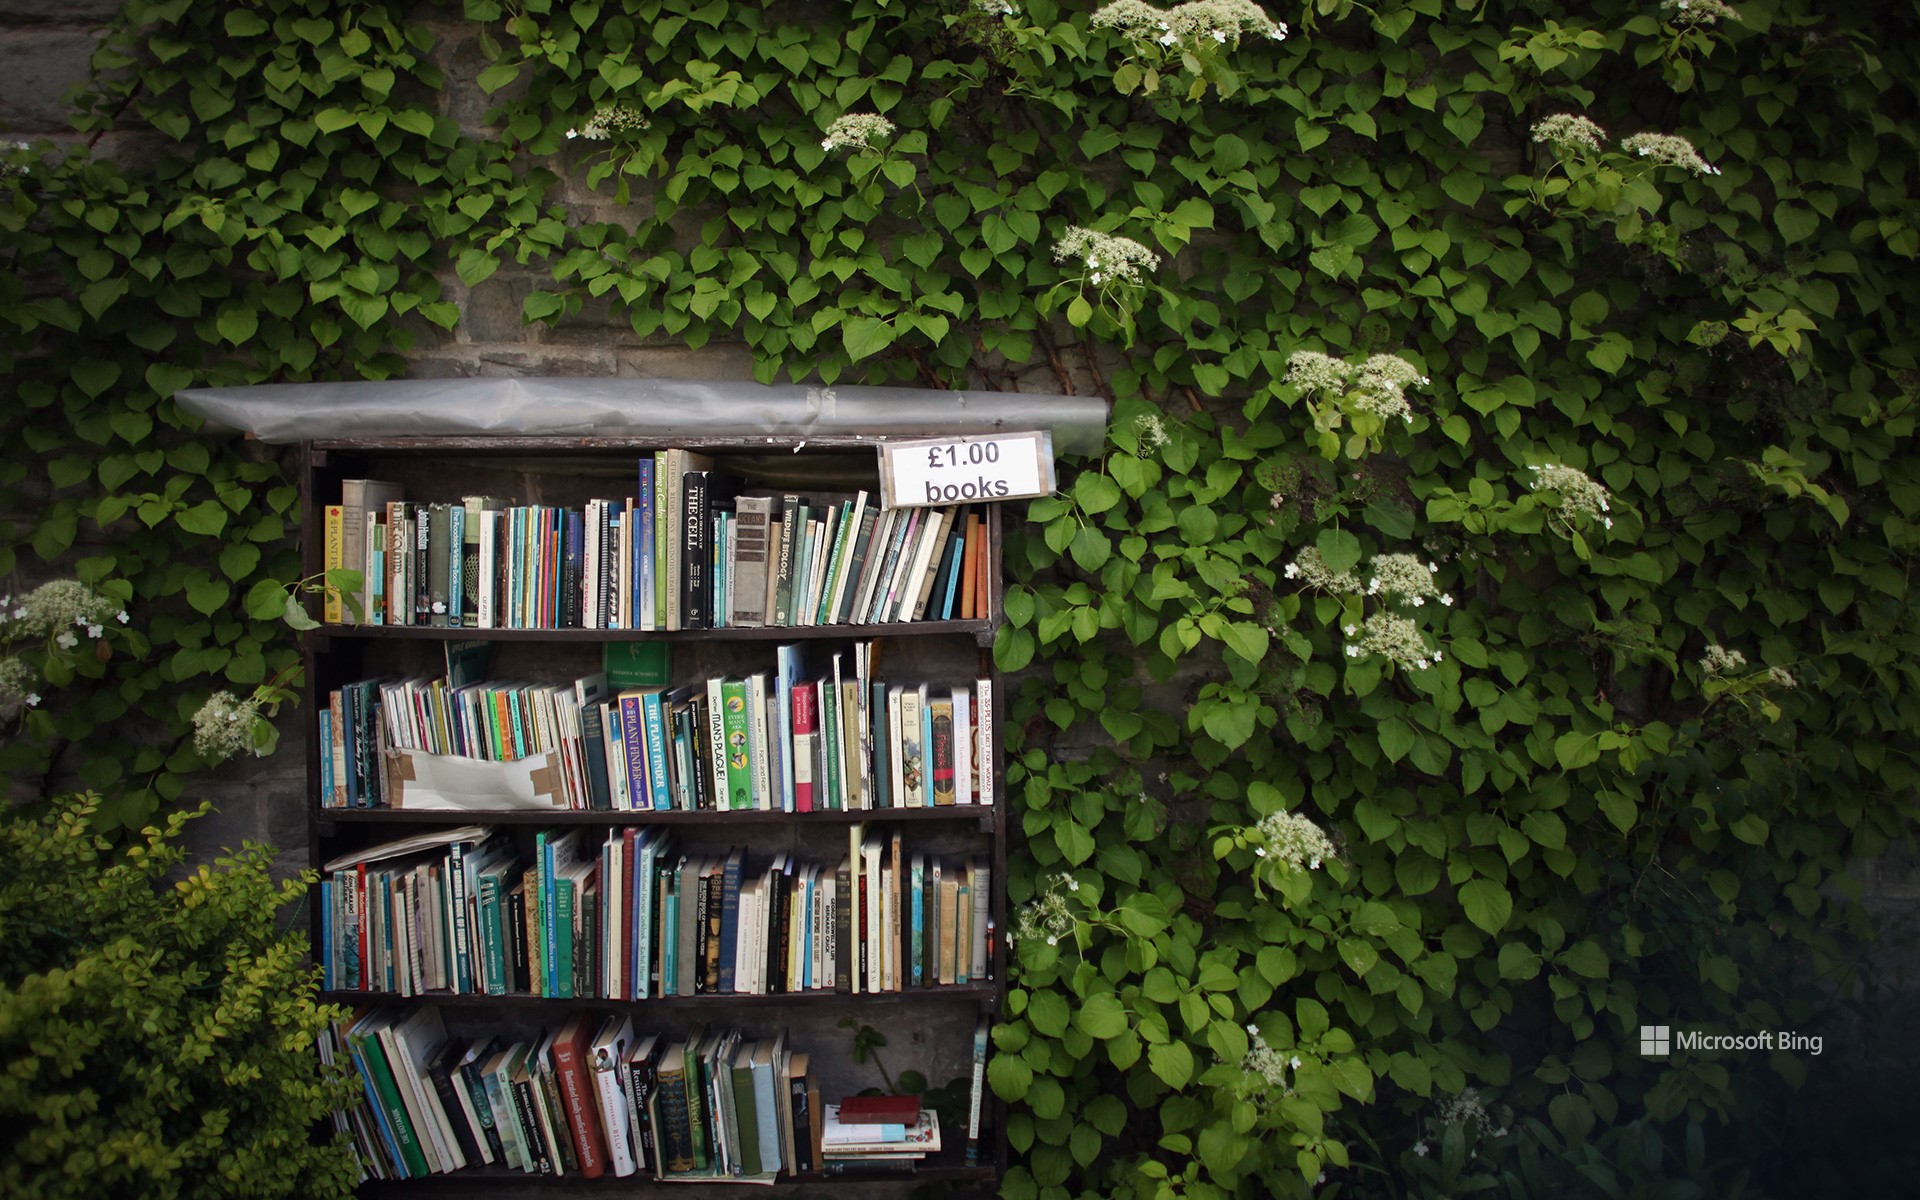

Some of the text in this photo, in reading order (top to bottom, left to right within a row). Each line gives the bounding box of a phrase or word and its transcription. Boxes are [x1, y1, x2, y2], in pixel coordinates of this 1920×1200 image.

[656, 457, 664, 486] Planning
[928, 442, 999, 468] £1.00
[925, 476, 1009, 502] books
[657, 494, 665, 519] Garden
[687, 486, 698, 550] THE CELL
[738, 513, 764, 524] OCEANS
[393, 514, 402, 576] THE COUNTRY
[418, 509, 429, 550] John Huston
[699, 542, 703, 550] OF
[780, 509, 793, 580] WILDLIFE BIOLOGY
[822, 520, 845, 605] PRACTICAL FUNGAL PHYSIOLOGY
[627, 715, 638, 745] PLANT
[712, 713, 721, 742] MAN'S
[649, 703, 664, 788] THE PLANT FINDER
[712, 743, 725, 781] PLAGUE?
[936, 734, 946, 767] Physik
[629, 747, 641, 780] FINDER
[452, 846, 460, 859] THE
[453, 869, 463, 898] GARDEN
[455, 899, 463, 918] BOOK
[456, 918, 464, 928] OF
[457, 928, 466, 954] EUROPE
[548, 927, 556, 956] ENGLAND'S
[519, 1084, 535, 1127] THE SMALL GARDEN
[632, 1070, 644, 1110] Resistance
[970, 1065, 983, 1137] FUTURE LANDSCAPES
[392, 1108, 410, 1144] DIE BOTANIK
[564, 1070, 594, 1167] Illustrated family medical encyclopaedia
[607, 1096, 616, 1126] STEPHENSON
[613, 1129, 622, 1150] BILLY
[689, 1096, 702, 1132] Weeds
